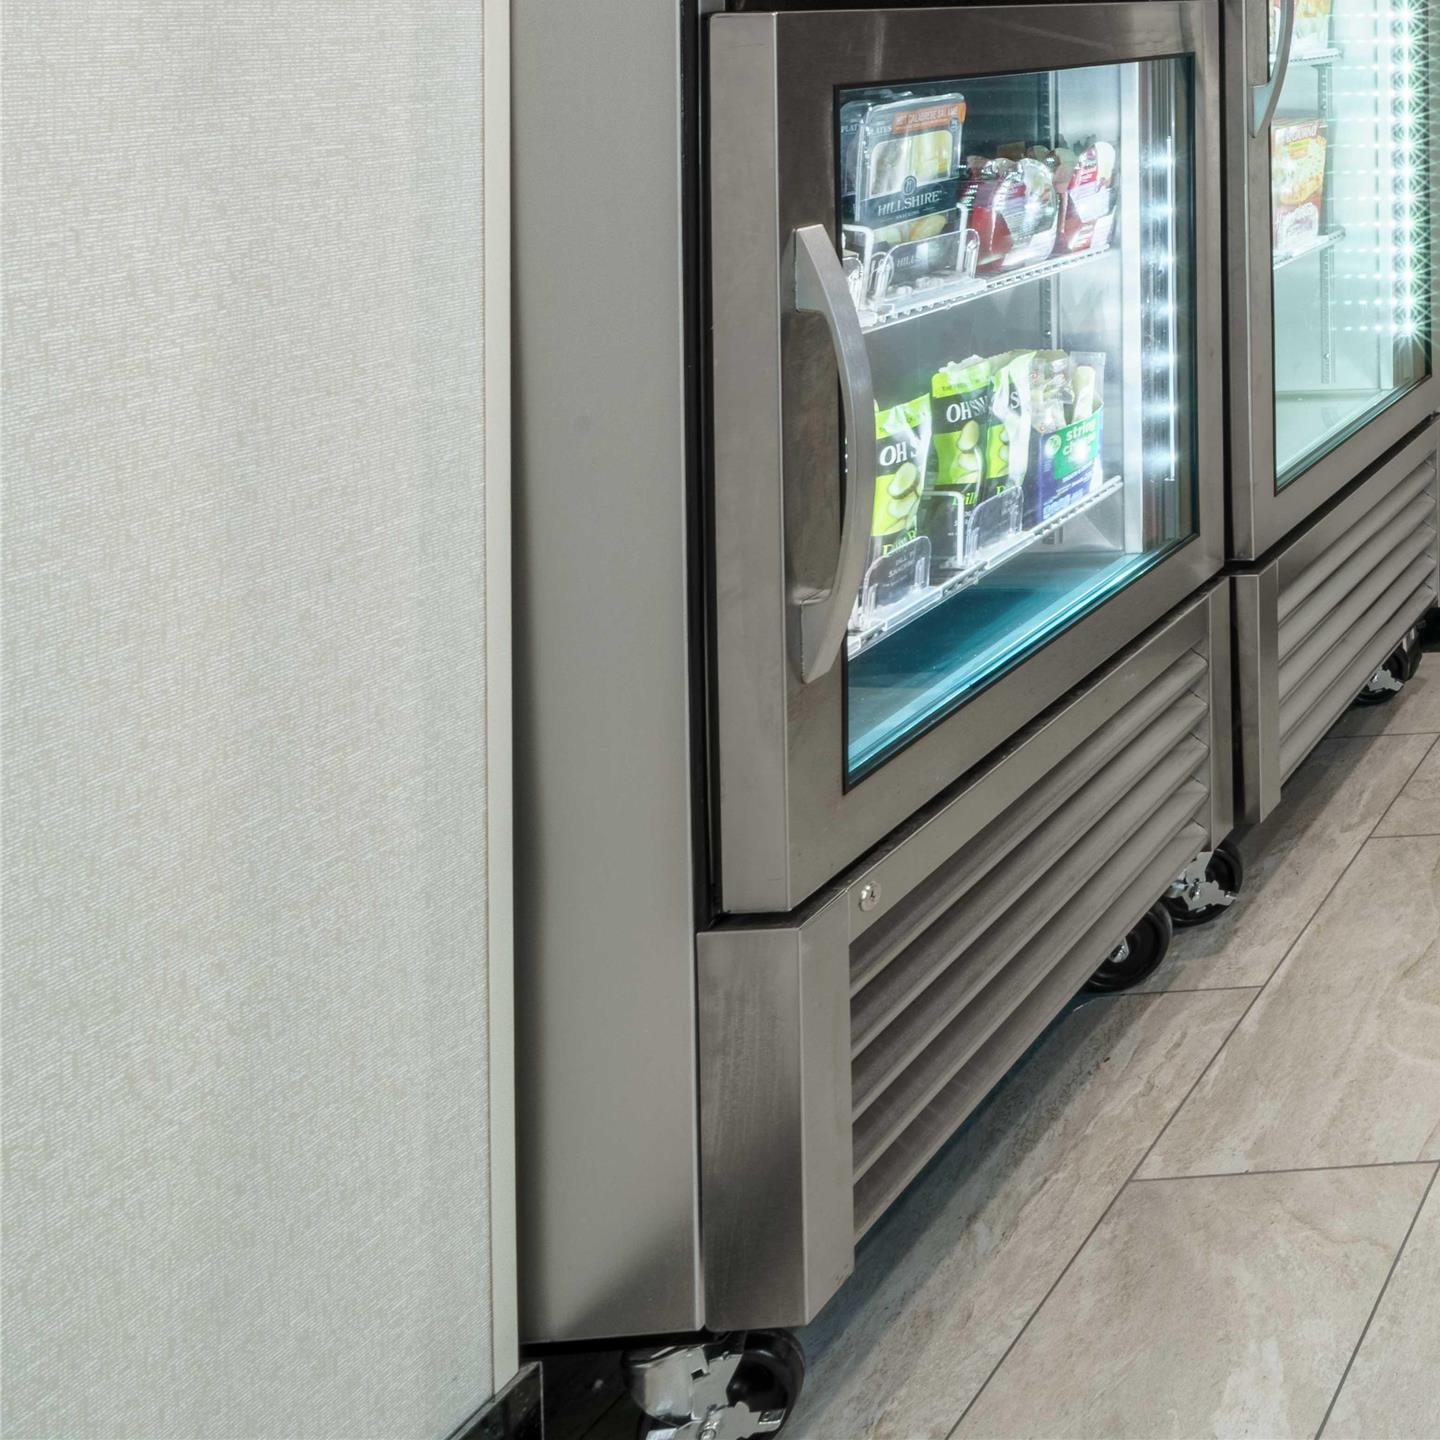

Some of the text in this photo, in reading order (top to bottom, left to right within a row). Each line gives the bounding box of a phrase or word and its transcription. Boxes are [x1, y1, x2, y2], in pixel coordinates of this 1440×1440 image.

[877, 190, 943, 217] HILLSHIRE
[946, 401, 973, 423] OH
[880, 441, 908, 466] OH
